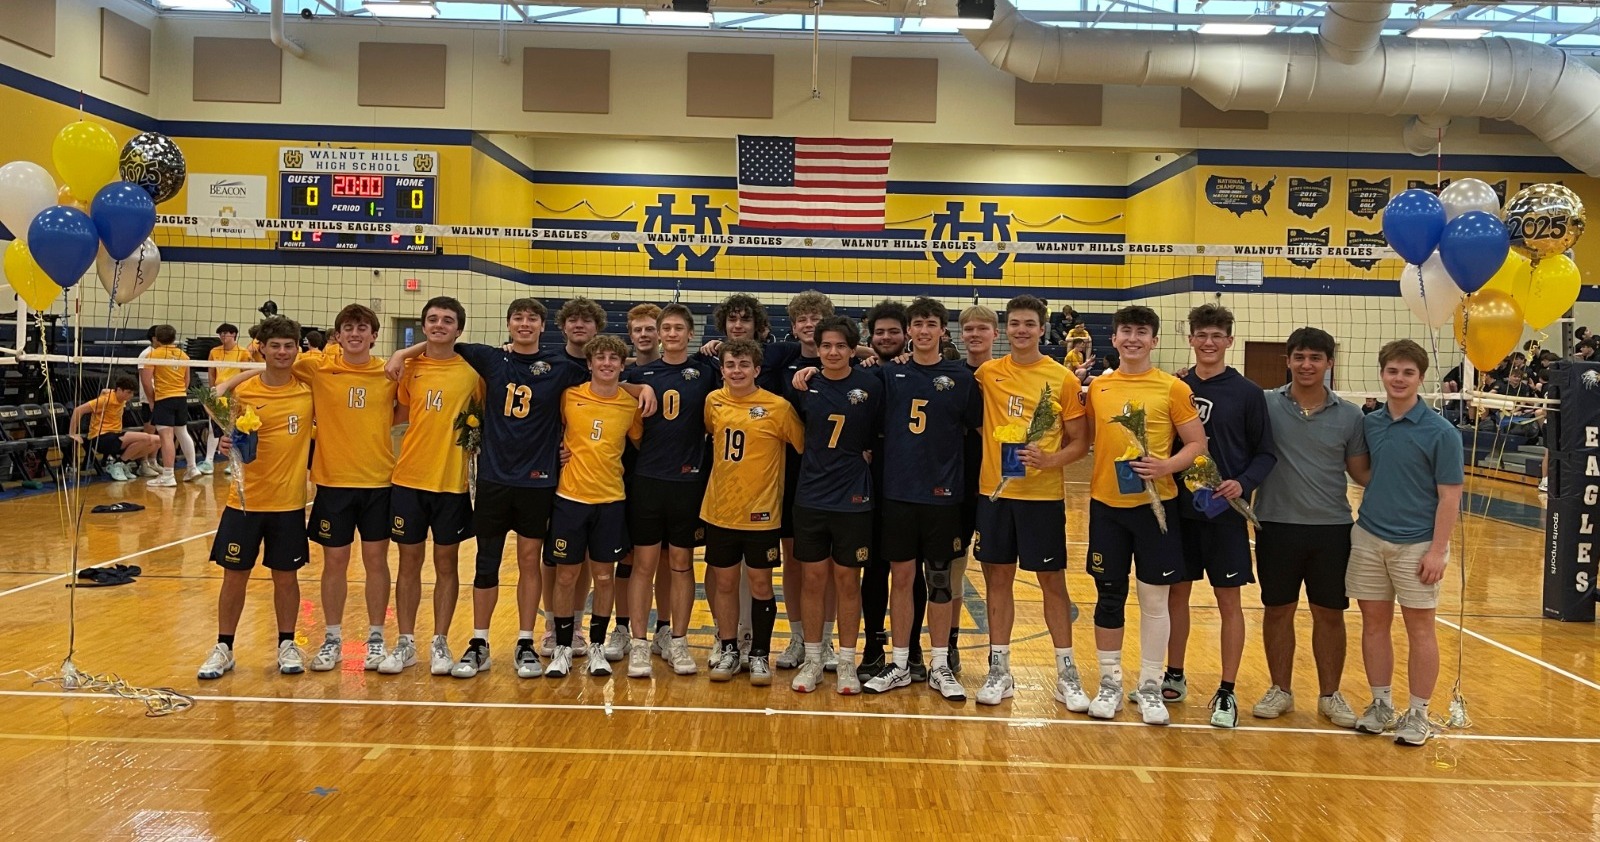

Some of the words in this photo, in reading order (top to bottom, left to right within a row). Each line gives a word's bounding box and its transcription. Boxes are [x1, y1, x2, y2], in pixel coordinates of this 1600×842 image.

[310, 151, 366, 160] WALNUT
[371, 152, 408, 162] HILLS
[316, 162, 346, 170] HIGH
[352, 162, 400, 172] SCHOOL
[288, 175, 320, 184] GUEST
[334, 176, 382, 196] 20:00
[396, 178, 425, 187] HOME
[306, 187, 318, 206] 0
[411, 190, 423, 209] 0
[332, 204, 360, 212] PERIOD
[156, 215, 198, 225] EAGLES
[256, 219, 304, 229] WALNUT
[308, 222, 342, 230] HILLS
[348, 222, 392, 232] EAGLES
[1509, 215, 1567, 240] 2025
[451, 226, 500, 236] WALNUT
[504, 228, 538, 238] HILLS
[544, 230, 588, 239] EAGLES
[647, 234, 695, 243] WALNUT
[700, 234, 734, 244] HILLS
[738, 236, 782, 245] EAGLES
[842, 239, 888, 248] WALNUT
[894, 240, 928, 249] HILLS
[932, 241, 976, 250] EAGLES
[1036, 243, 1084, 252] WALNUT
[1090, 244, 1124, 252] HILLS
[1129, 244, 1174, 253] EAGLES
[1234, 246, 1283, 255] WALNUT
[1288, 247, 1322, 255] HILLS
[1328, 248, 1372, 256] EAGLES
[348, 387, 366, 409] 13
[426, 390, 443, 412] 14
[504, 382, 533, 418] 13
[662, 389, 680, 421] 0
[1008, 394, 1024, 418] 15
[288, 415, 298, 435] 6
[908, 398, 929, 434] 5
[590, 419, 604, 441] 5
[827, 414, 846, 448] 7
[724, 427, 746, 462] 19
[1576, 426, 1600, 593] EAGLES
